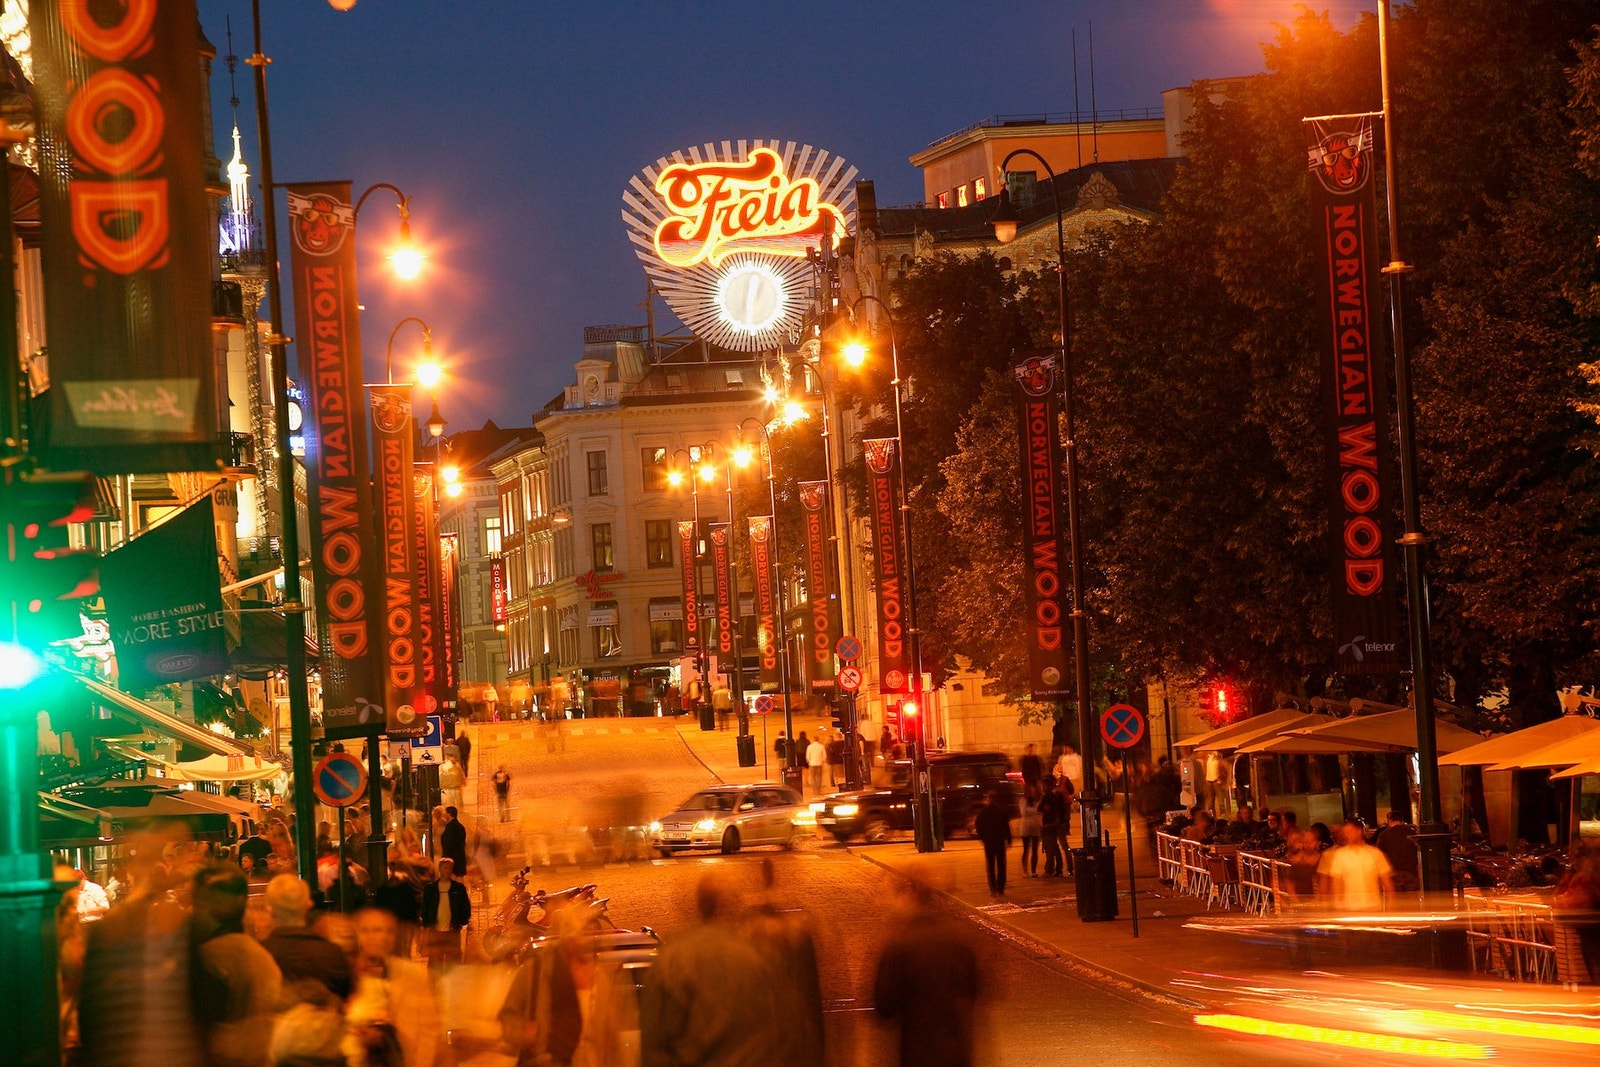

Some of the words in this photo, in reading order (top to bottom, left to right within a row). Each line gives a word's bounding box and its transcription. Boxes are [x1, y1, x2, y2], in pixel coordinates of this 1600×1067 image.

[654, 147, 847, 267] Freia
[1333, 204, 1367, 416] NORWEGIAN
[1030, 402, 1053, 537] NORWEGIAN
[876, 478, 894, 575] NORWEGIAN
[1337, 421, 1384, 597] WOOD
[684, 540, 694, 590] NORWEGIAN
[717, 547, 728, 604] NORWEGIAN
[757, 545, 771, 612] NORWEGIAN
[809, 514, 824, 595] NORWEGIAN
[117, 621, 172, 645] MORE
[177, 611, 224, 635] STYLE
[131, 610, 159, 622] MORE
[162, 602, 206, 618] FASHION
[686, 591, 697, 632] WOOD
[881, 579, 904, 658] WOOD
[1033, 539, 1062, 651] WOOD
[719, 605, 731, 652] WOOD
[761, 613, 776, 670] WOOD
[812, 597, 830, 663] WOOD
[1365, 642, 1396, 652] telenor
